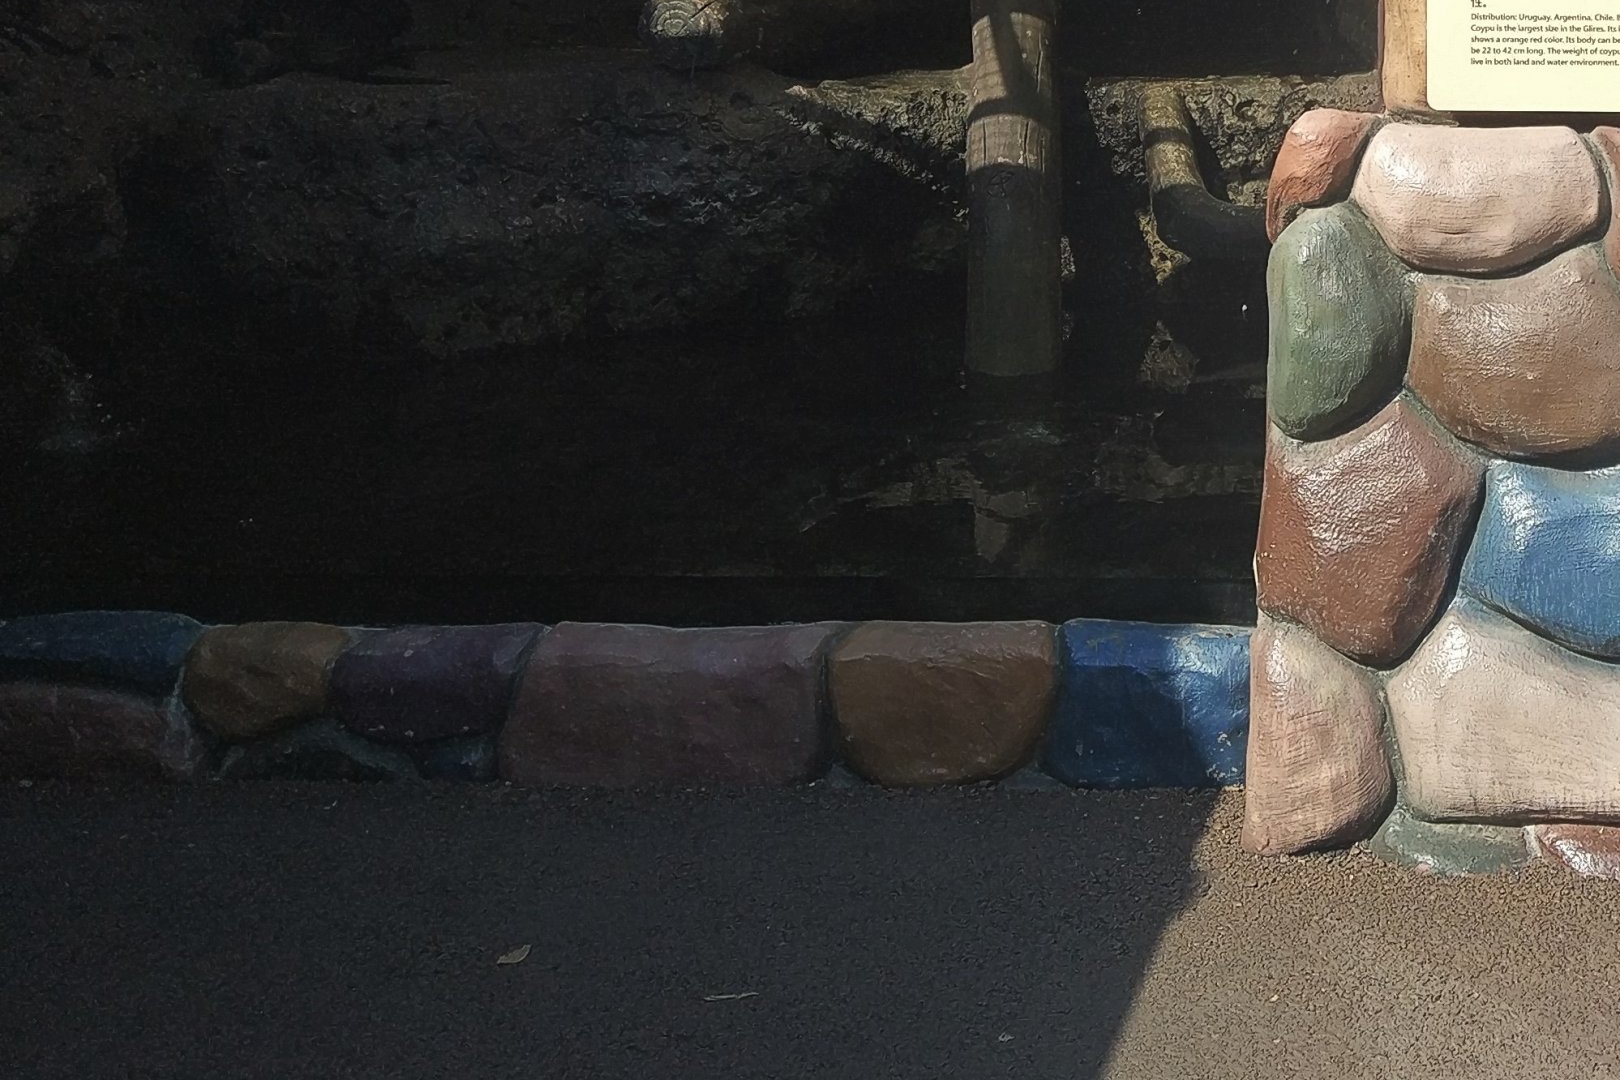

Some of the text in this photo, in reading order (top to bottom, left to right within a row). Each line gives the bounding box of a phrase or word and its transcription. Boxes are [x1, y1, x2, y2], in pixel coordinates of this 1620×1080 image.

[1470, 24, 1494, 34] Coypu
[1496, 24, 1502, 32] is
[1504, 24, 1516, 32] the
[1518, 24, 1544, 34] largest
[1560, 24, 1568, 32] in
[1568, 24, 1582, 32] the
[1502, 38, 1528, 46] orange
[1530, 36, 1542, 44] red
[1576, 36, 1596, 46] body
[1482, 46, 1492, 54] 22
[1502, 46, 1512, 54] 42
[1548, 46, 1562, 54] The
[1562, 48, 1588, 56] weight
[1470, 58, 1484, 66] live
[1494, 58, 1512, 66] both
[1514, 58, 1530, 66] land
